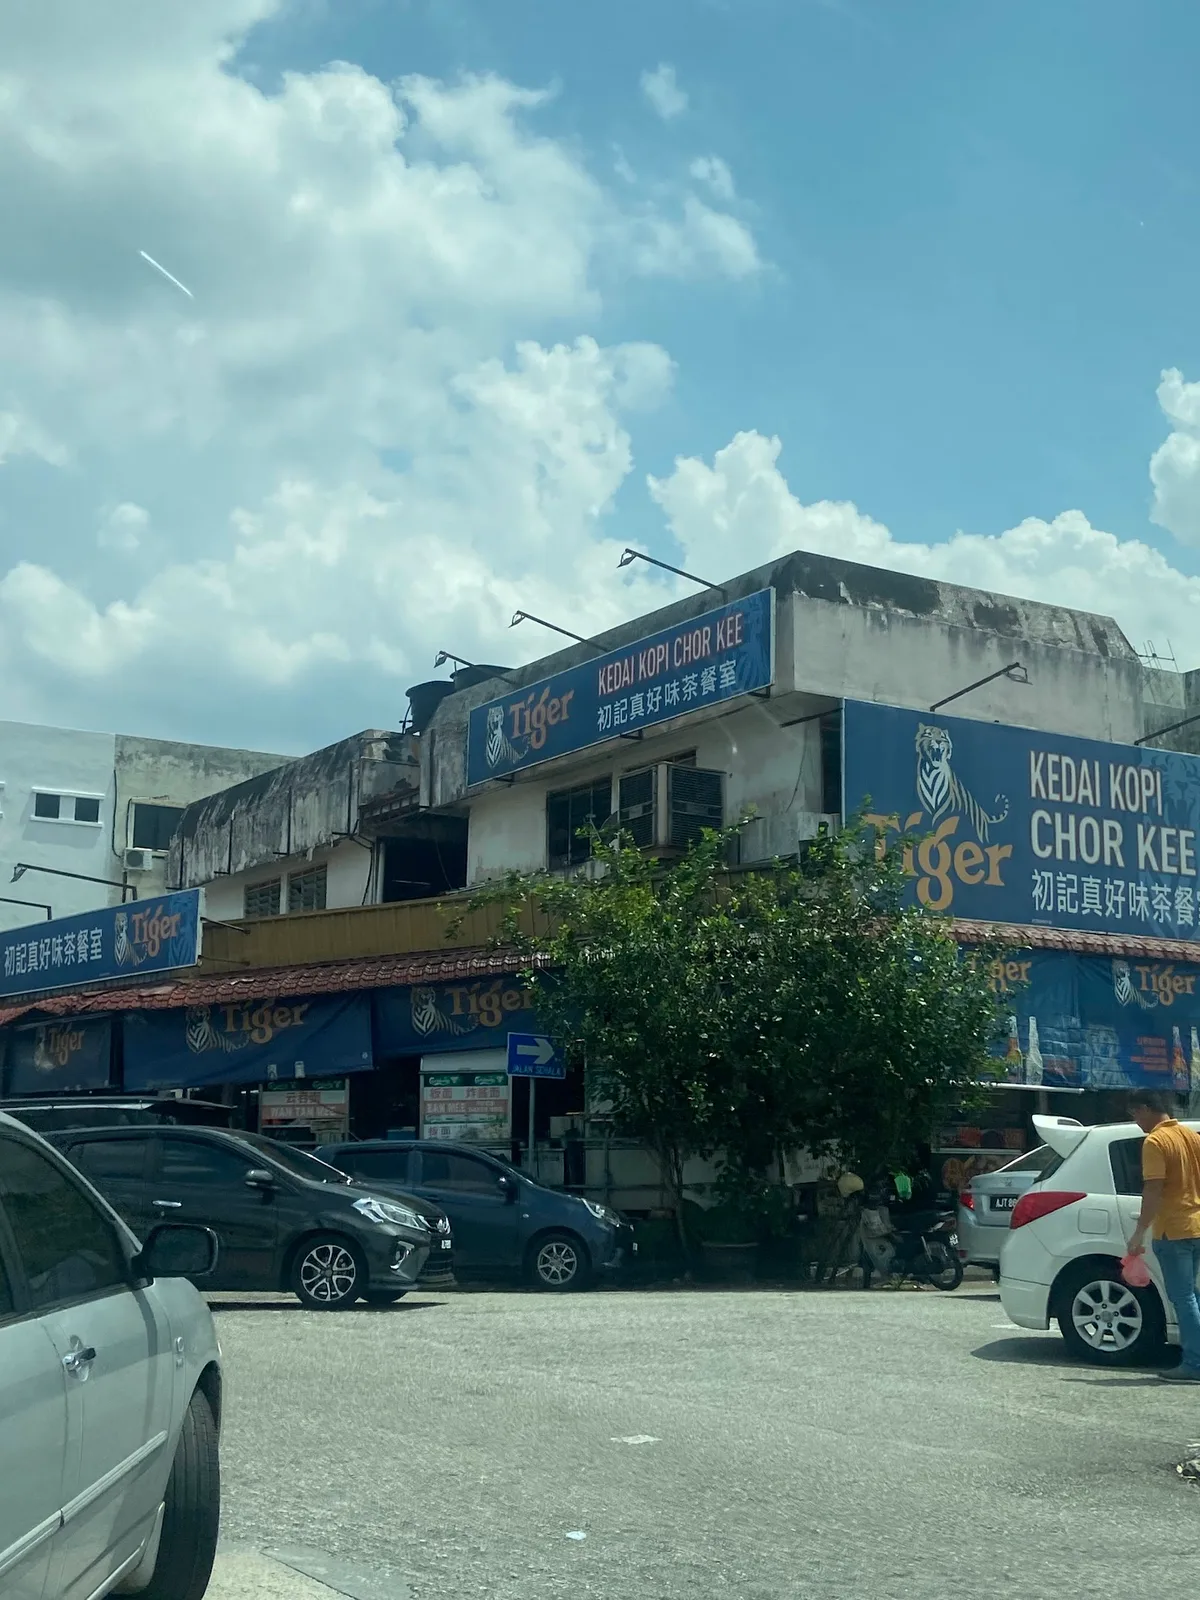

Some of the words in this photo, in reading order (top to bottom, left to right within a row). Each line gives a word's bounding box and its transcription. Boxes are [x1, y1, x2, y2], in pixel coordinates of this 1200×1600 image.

[599, 660, 635, 695] KEDAI
[638, 648, 669, 680] KOPI
[674, 633, 711, 667] CHOR
[716, 613, 743, 648] KEE
[509, 686, 575, 749] Tiger
[597, 659, 737, 731] 初記真好味茶餐室
[1030, 750, 1101, 807] KEDAI
[1109, 763, 1163, 816] KOPI
[1031, 809, 1125, 867] CHOR
[1137, 823, 1197, 876] KEE
[1032, 869, 1200, 928] 初記真好味茶餐
[4, 927, 103, 977] 初記真好味茶餐室
[131, 905, 181, 957] Tiger
[1135, 964, 1197, 1006] Tiger
[49, 1022, 86, 1066] Tiger
[220, 999, 310, 1044] Tiger
[271, 1106, 293, 1118] WAN
[295, 1106, 315, 1118] TAN
